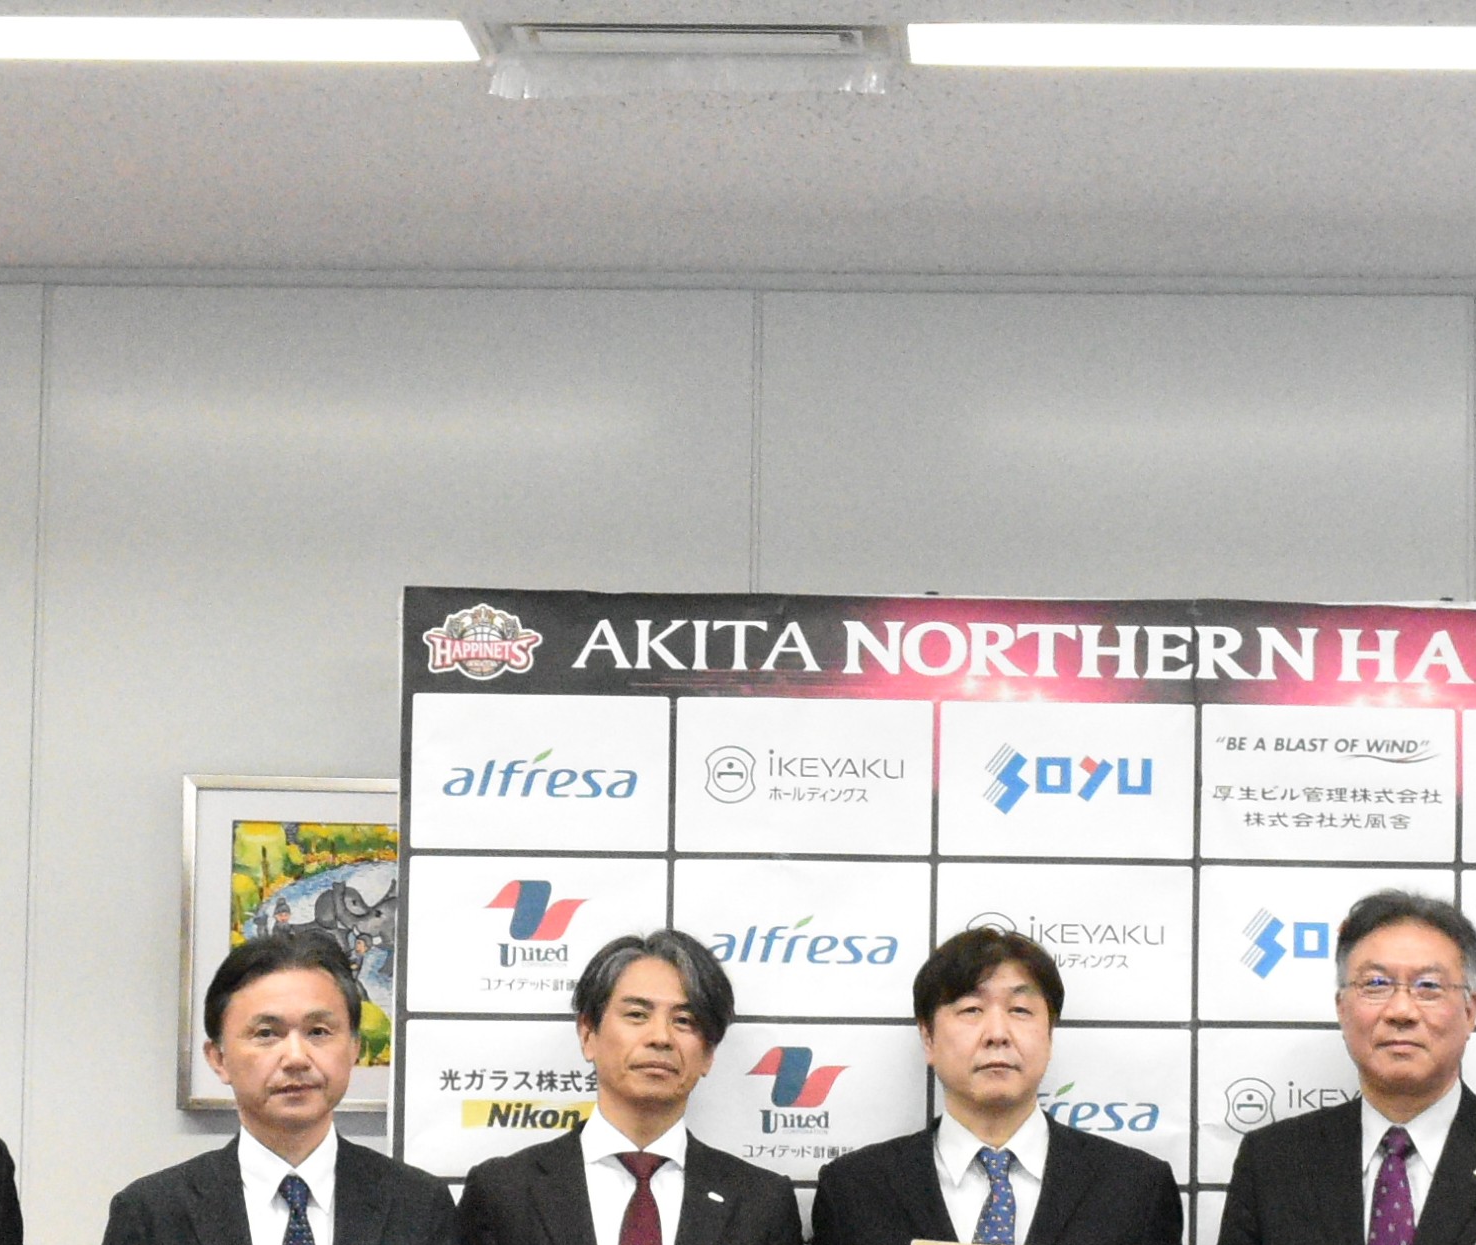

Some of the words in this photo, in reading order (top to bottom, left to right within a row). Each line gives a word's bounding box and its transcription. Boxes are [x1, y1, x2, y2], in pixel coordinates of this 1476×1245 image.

[428, 633, 539, 669] HAPPINETS
[571, 619, 822, 672] AKITA
[842, 619, 1320, 682] NORTHERN
[1253, 738, 1267, 751] A
[1274, 738, 1328, 752] BLAST
[1334, 739, 1359, 753] OF
[442, 758, 639, 799] alfresa
[769, 786, 869, 803] ホールディングス
[1212, 785, 1443, 805] 厚生ビル管理株式会社
[1243, 811, 1412, 830] 株式会社光風舎
[497, 943, 569, 968] United
[1051, 953, 1129, 969] ルディングス
[486, 1102, 580, 1129] Nikon
[759, 1109, 830, 1134] United
